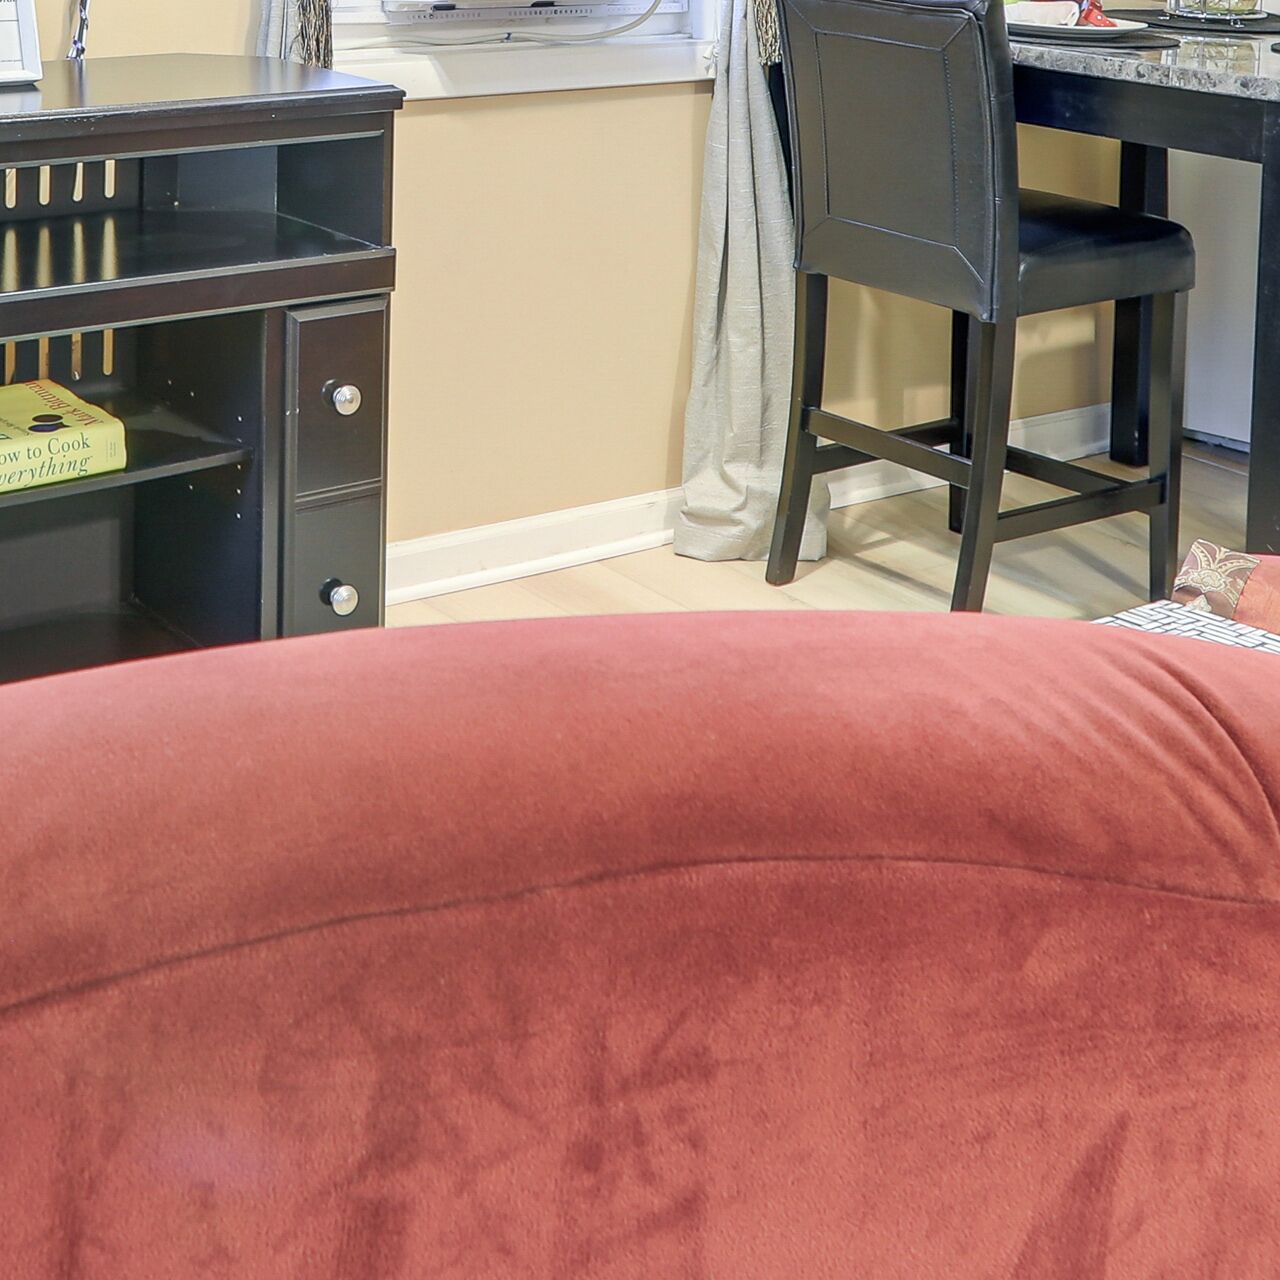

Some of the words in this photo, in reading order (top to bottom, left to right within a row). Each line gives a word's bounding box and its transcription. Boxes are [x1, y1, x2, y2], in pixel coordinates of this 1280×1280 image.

[62, 407, 104, 426] Mark
[27, 448, 42, 460] to
[47, 432, 91, 456] Cook
